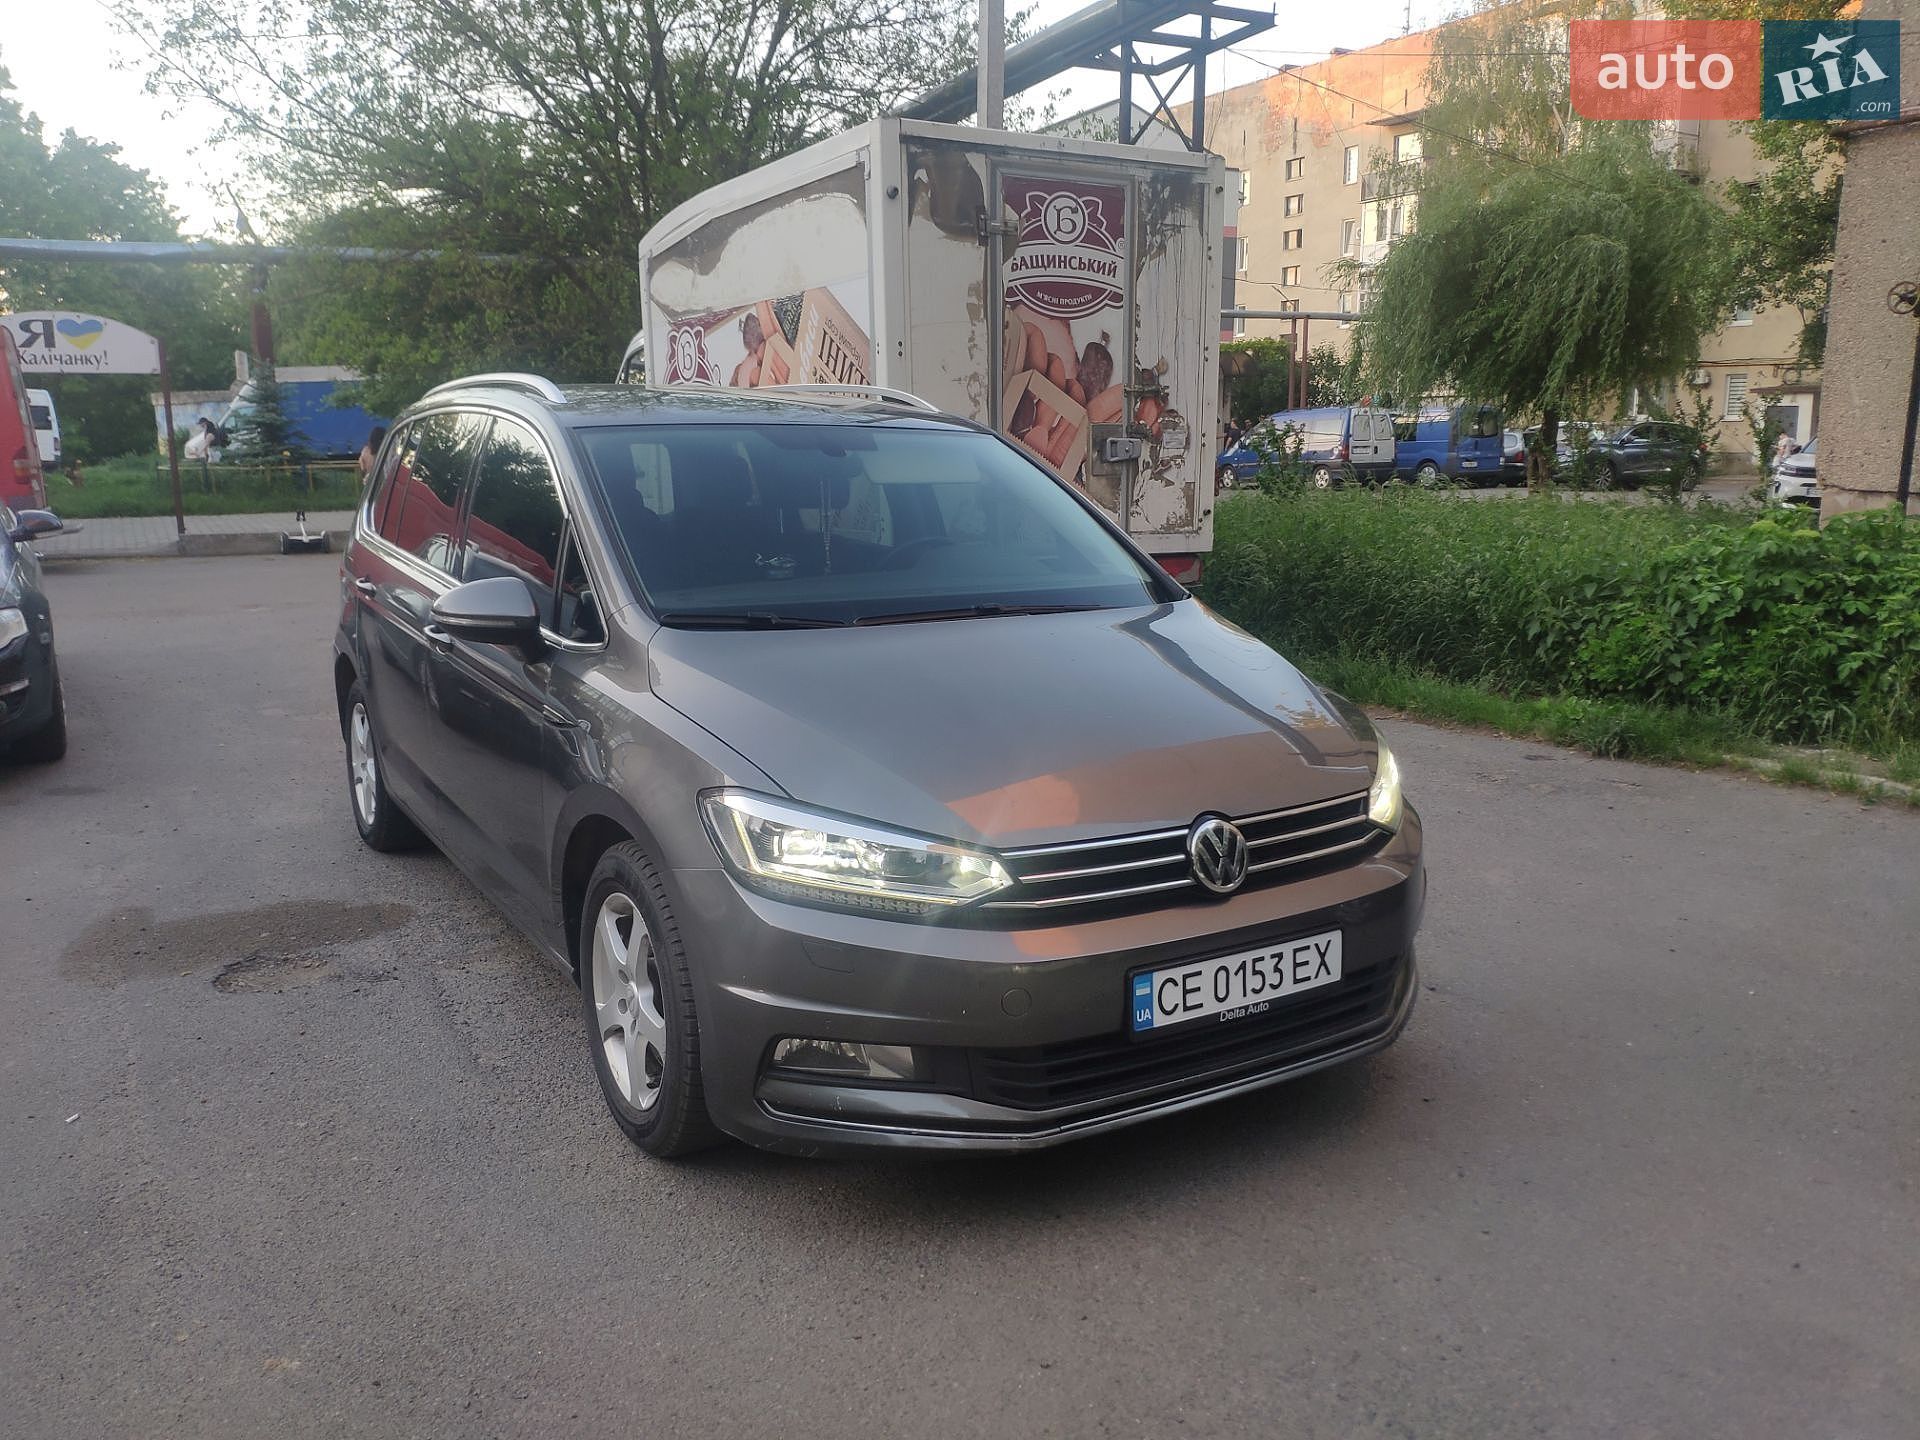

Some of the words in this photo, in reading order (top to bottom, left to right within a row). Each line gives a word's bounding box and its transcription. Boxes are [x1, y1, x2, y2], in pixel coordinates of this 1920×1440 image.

[1060, 293, 1093, 306] ПРОДУКТИ
[18, 319, 56, 349] Я
[1157, 970, 1204, 1016] CE
[1213, 951, 1284, 1004] 0153
[1292, 939, 1332, 985] EX
[1136, 1008, 1152, 1022] UA
[1219, 1007, 1246, 1023] Delta
[1247, 1001, 1270, 1016] Auto
